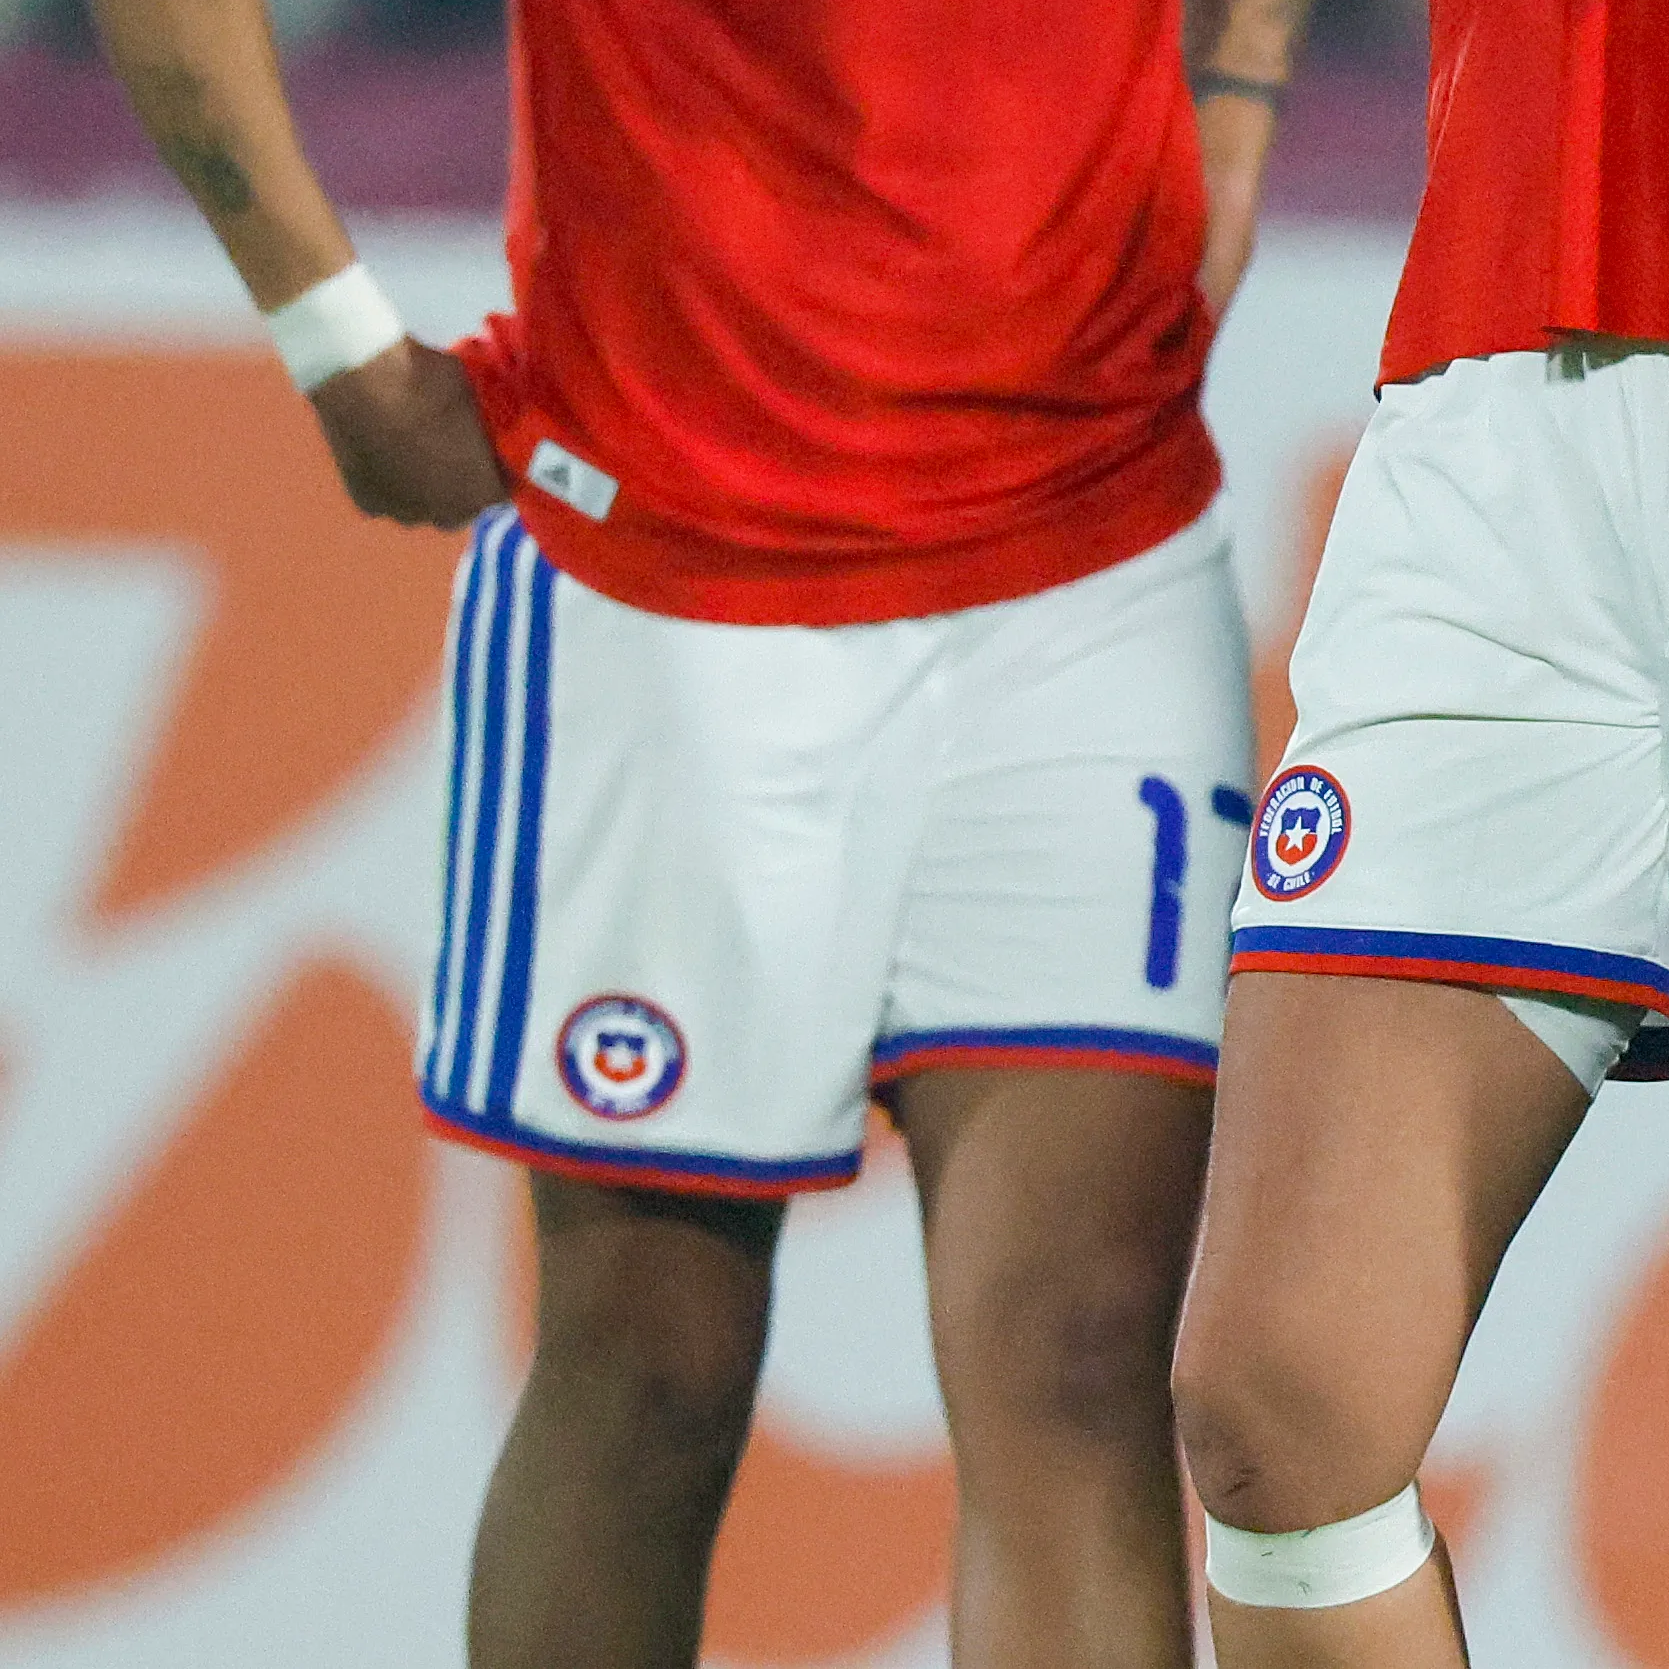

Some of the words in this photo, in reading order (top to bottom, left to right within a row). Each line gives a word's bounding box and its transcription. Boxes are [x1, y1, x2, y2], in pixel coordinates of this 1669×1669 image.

[1258, 775, 1305, 838] FEDERACION
[1309, 776, 1324, 794] DE
[1323, 788, 1344, 835] FUTBOL
[1267, 873, 1282, 889] DE
[1283, 871, 1311, 892] CHILE
